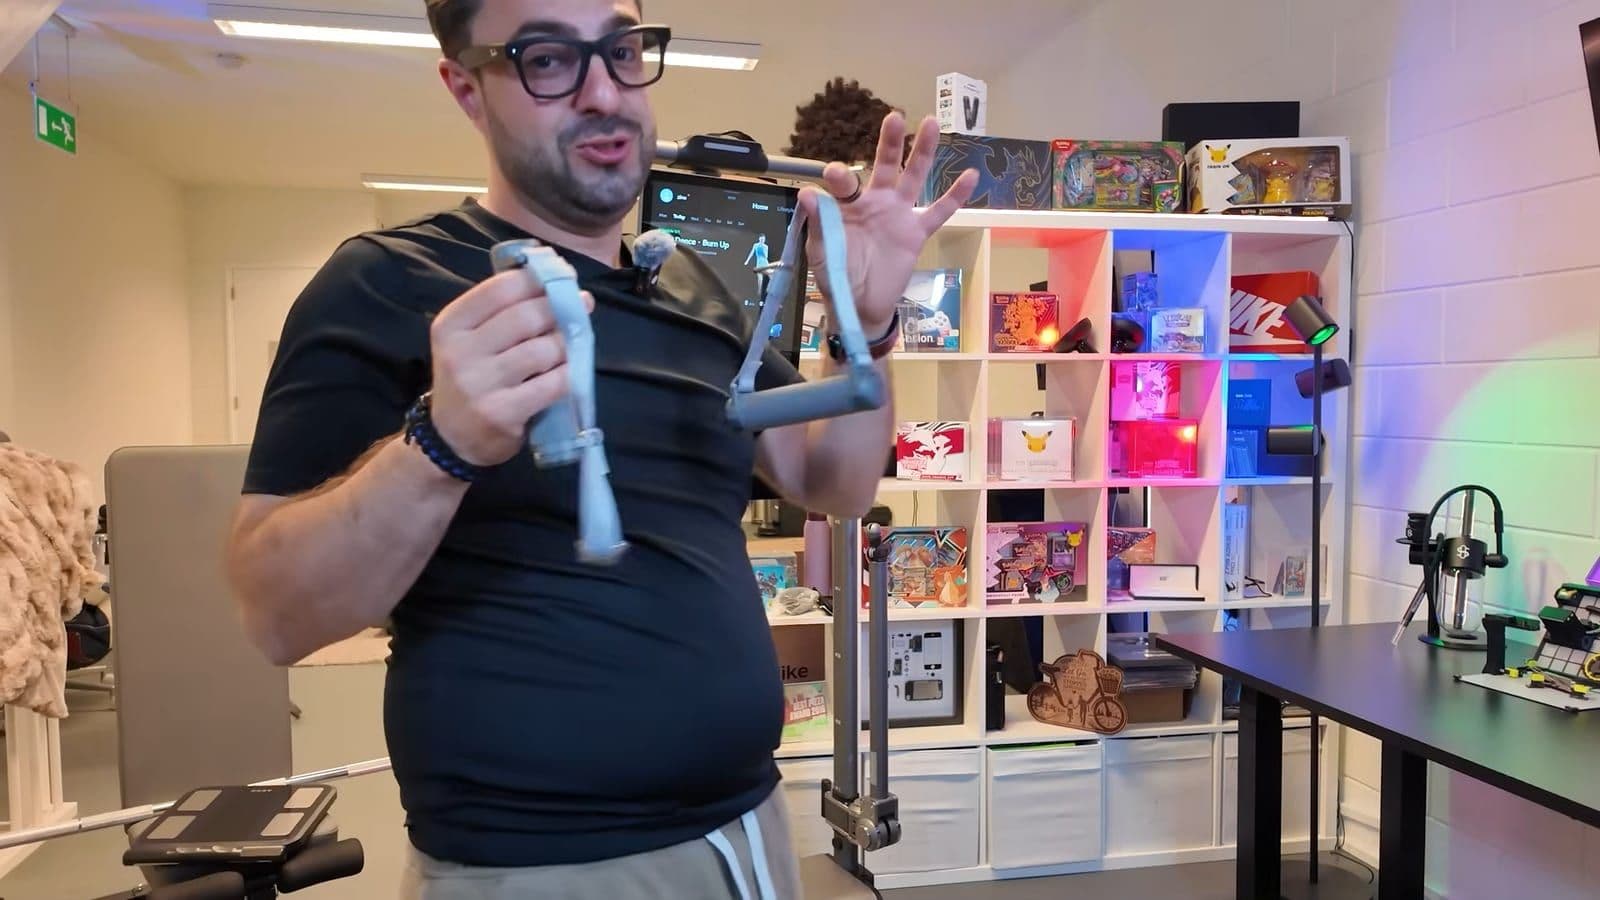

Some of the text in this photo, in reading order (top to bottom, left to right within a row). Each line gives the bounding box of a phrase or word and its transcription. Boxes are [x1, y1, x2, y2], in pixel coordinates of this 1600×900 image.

[752, 202, 769, 210] Home
[702, 239, 719, 247] Burn
[719, 240, 730, 250] Up
